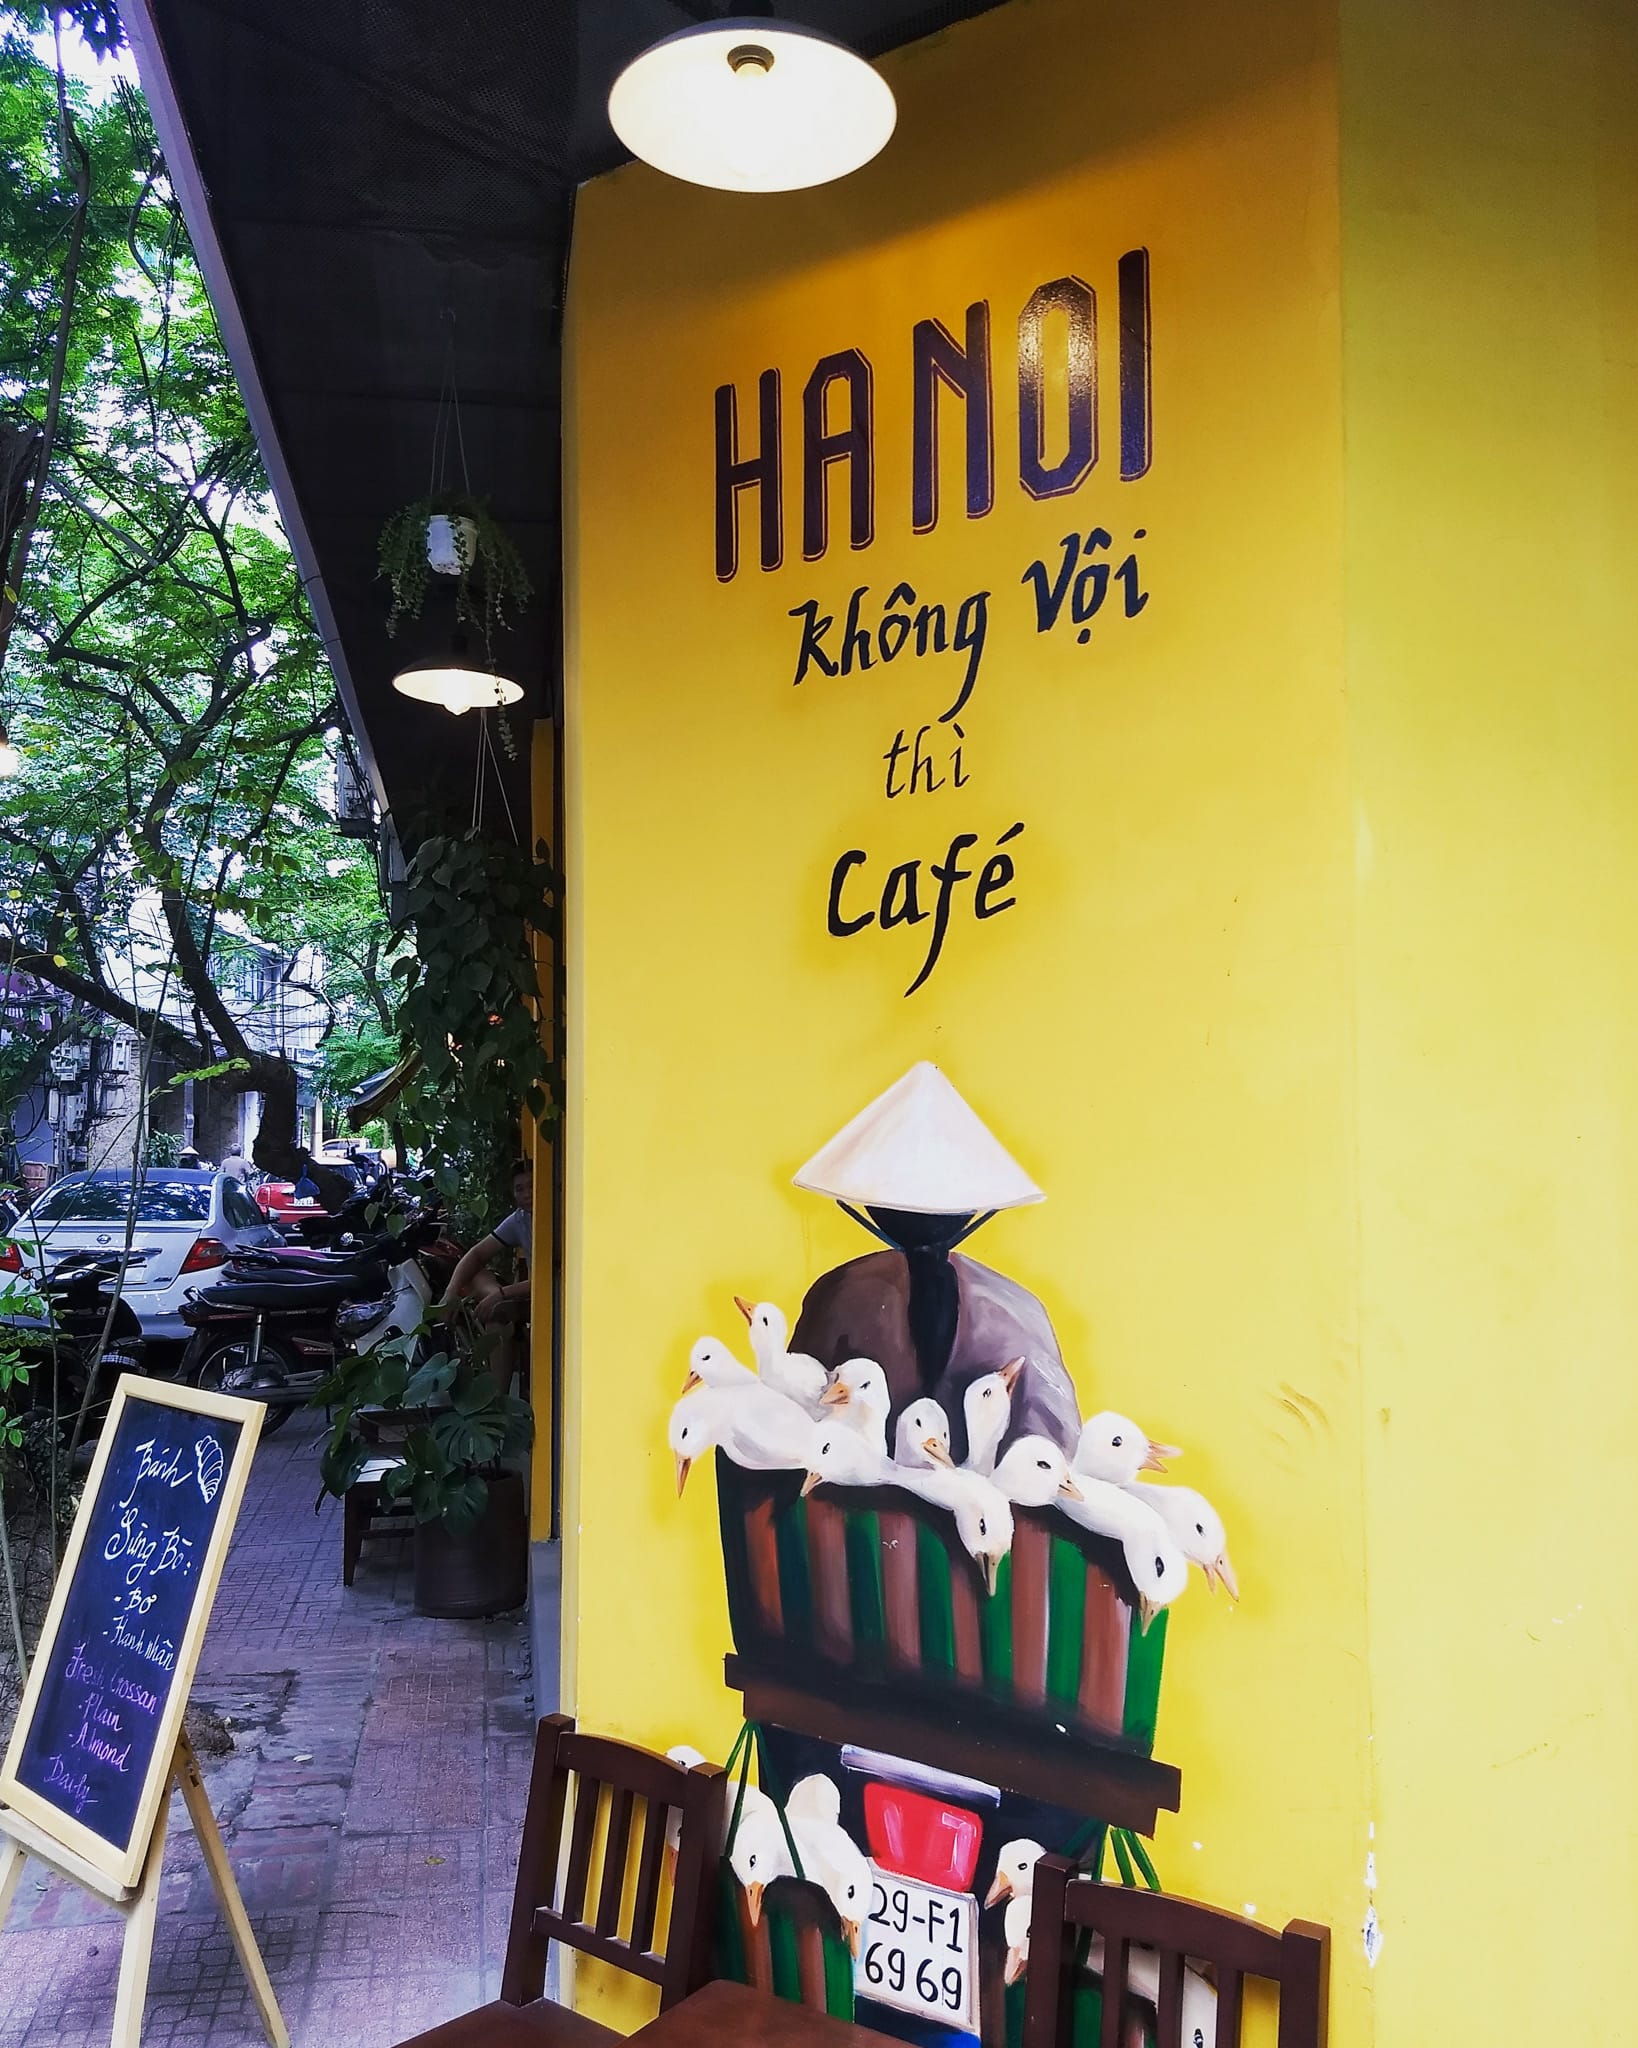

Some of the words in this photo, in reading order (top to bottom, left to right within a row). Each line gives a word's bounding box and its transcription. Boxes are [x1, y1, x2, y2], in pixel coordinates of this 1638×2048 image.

[714, 245, 1153, 583] HANOI
[1021, 527, 1149, 645] Vội
[883, 722, 970, 799] thì
[827, 822, 1025, 998] Café
[868, 1882, 964, 1953] 29-F1
